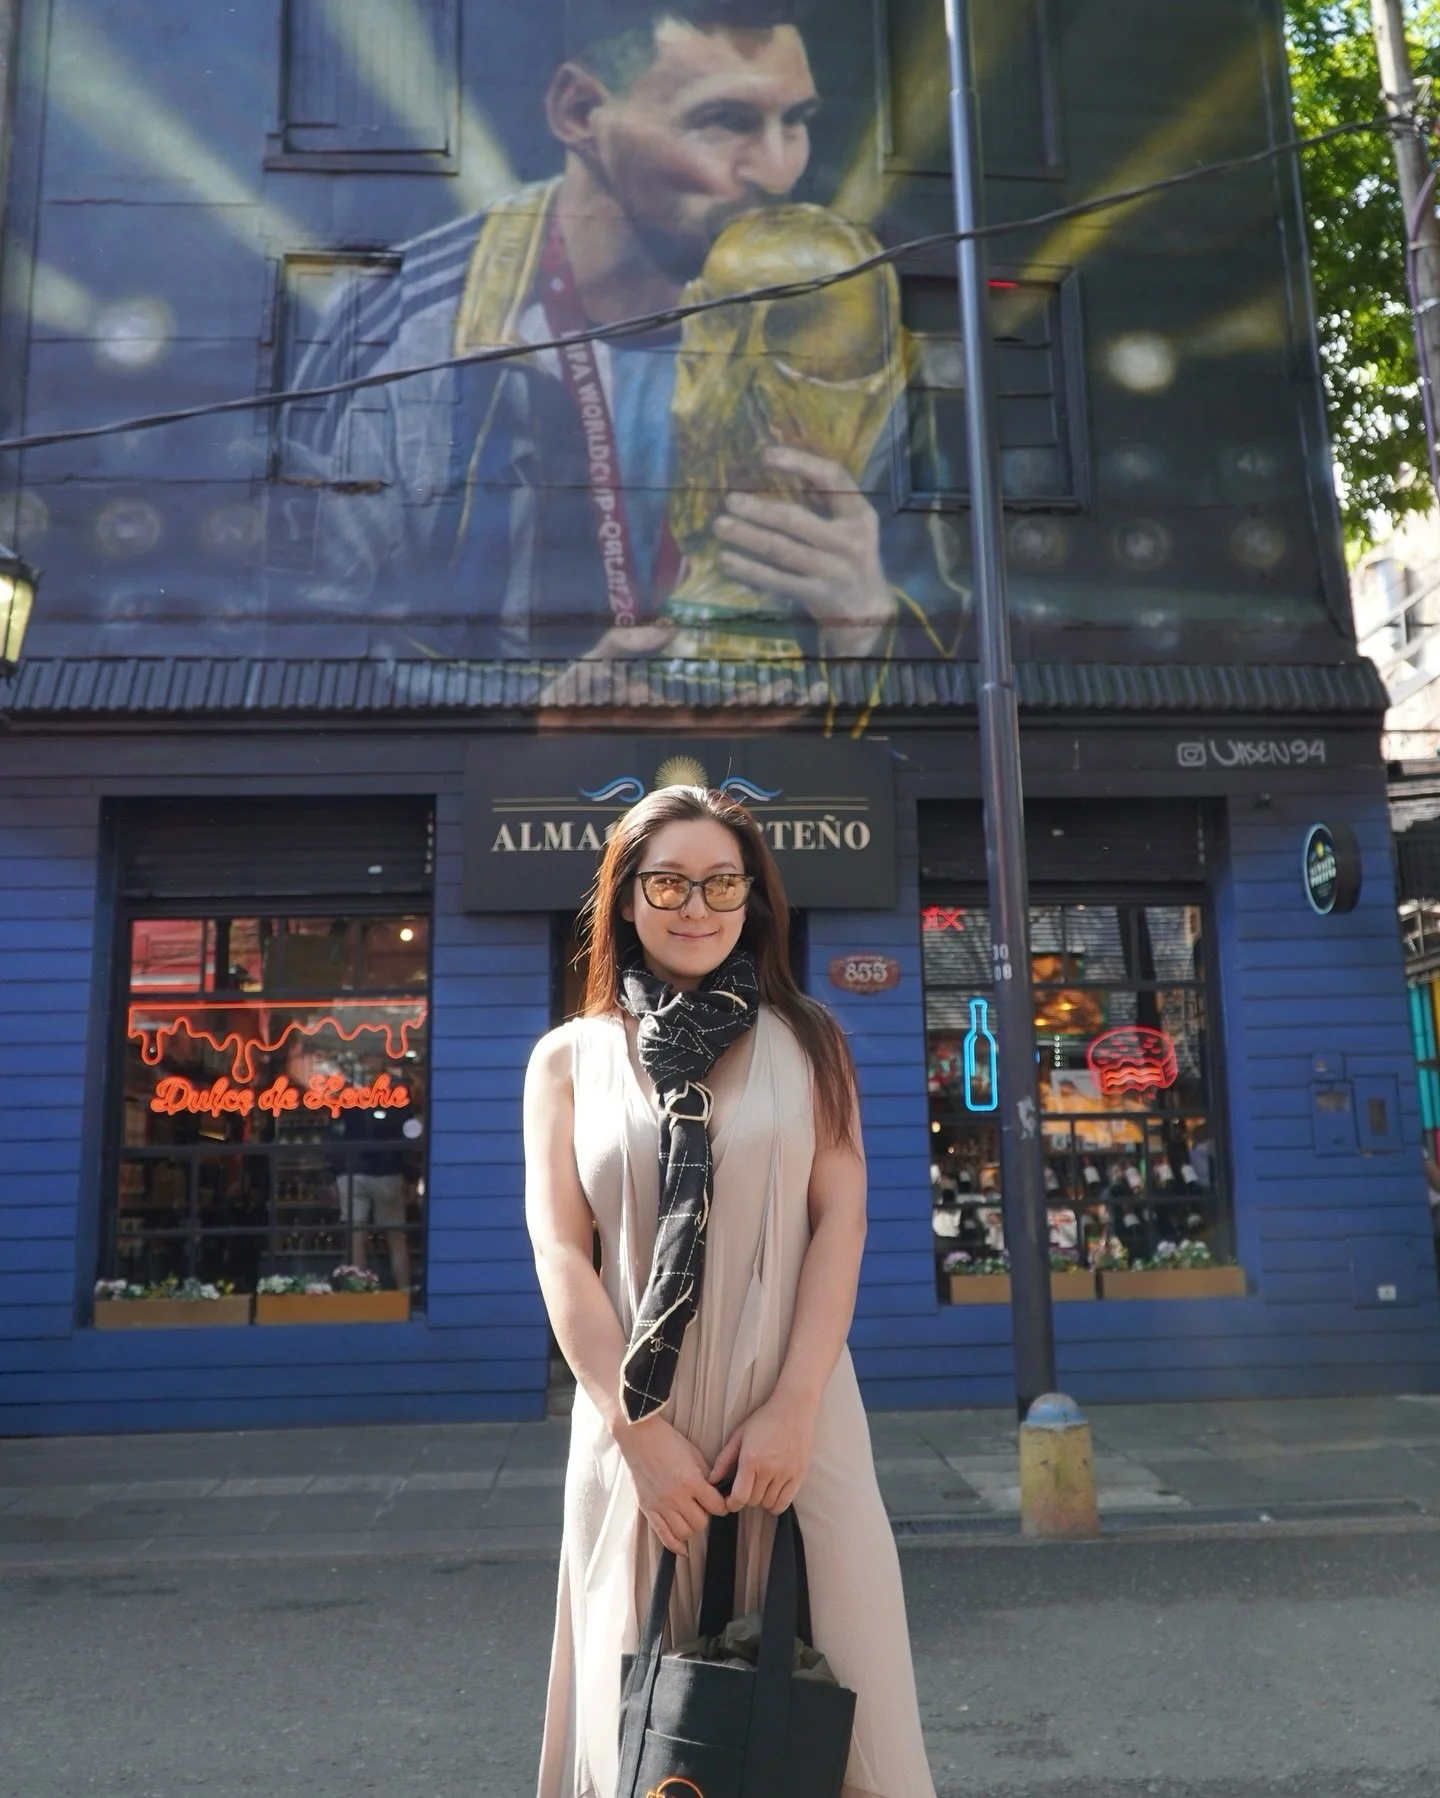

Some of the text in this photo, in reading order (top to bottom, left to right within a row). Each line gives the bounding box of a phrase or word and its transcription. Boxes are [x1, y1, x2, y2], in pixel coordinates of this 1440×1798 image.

[561, 330, 593, 381] IFA
[756, 813, 871, 851] TEÑO
[150, 1073, 410, 1119] Dulce de Leche
